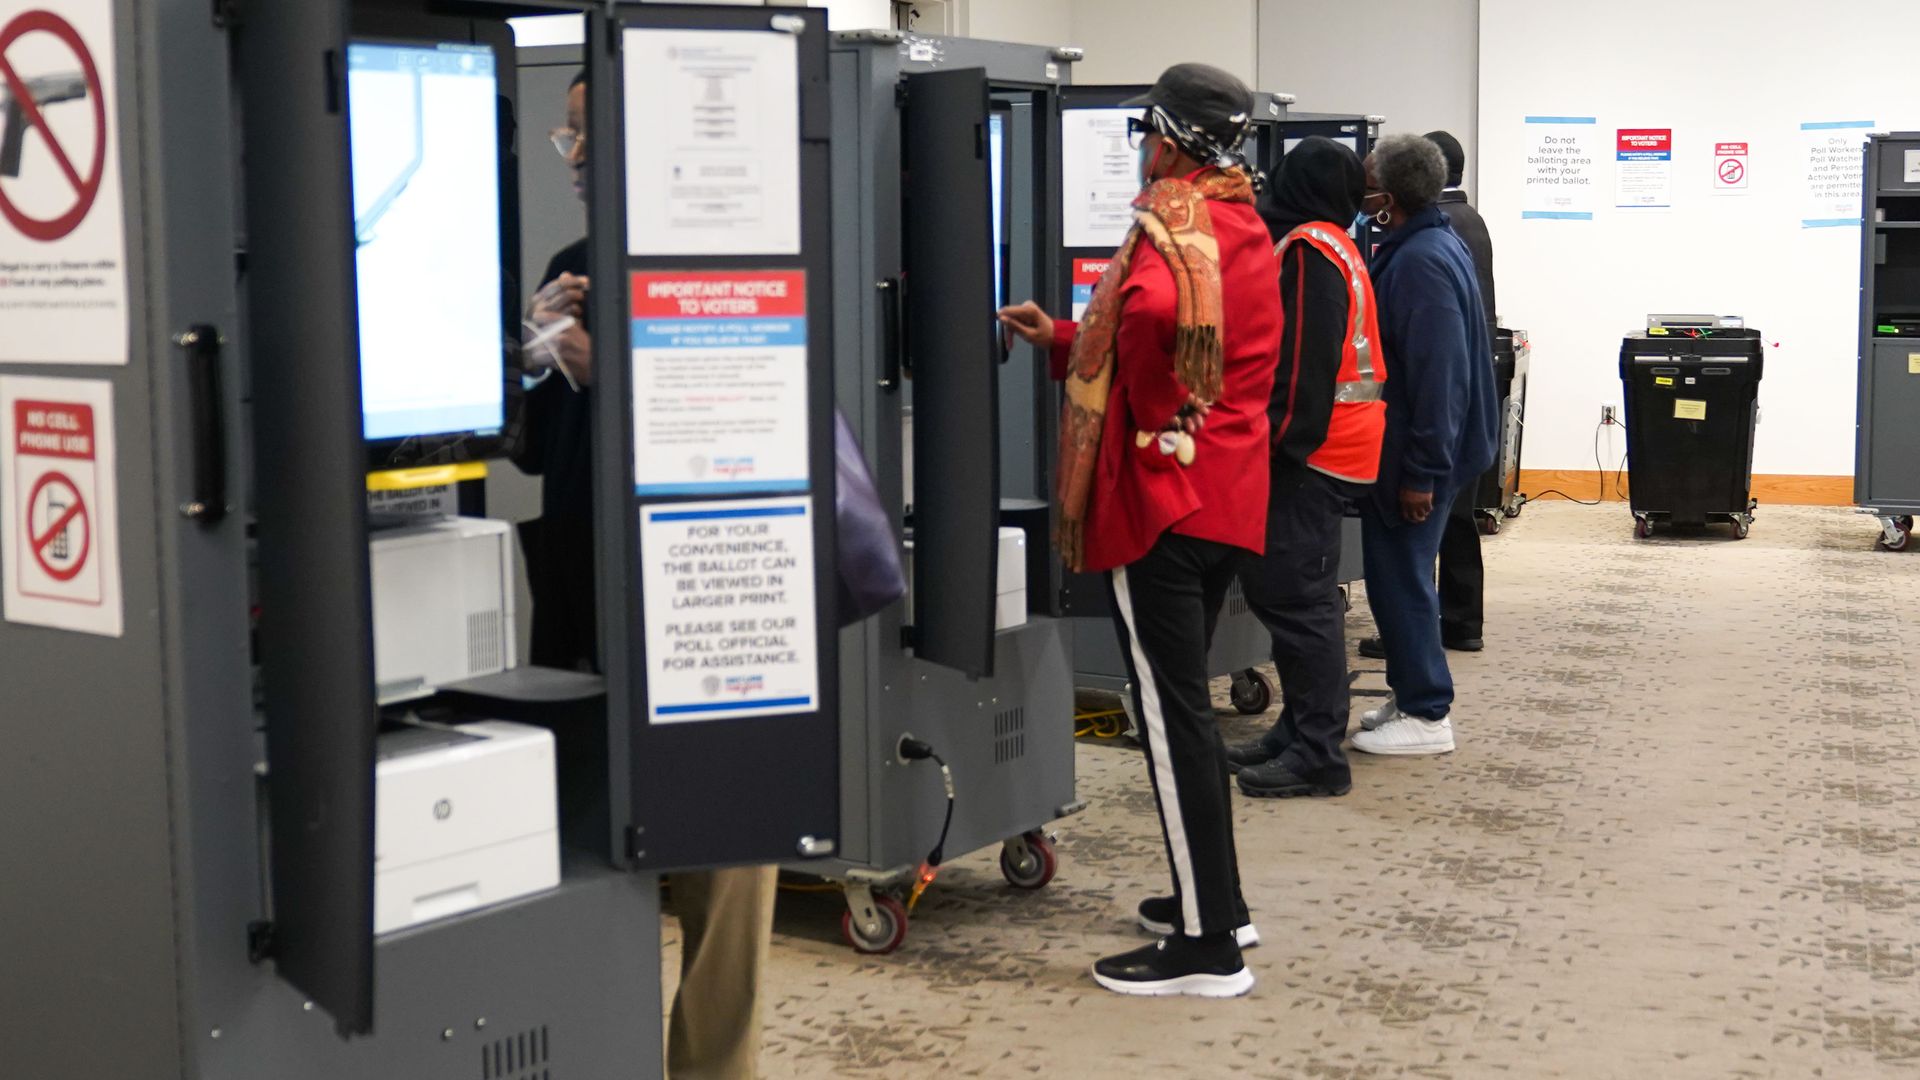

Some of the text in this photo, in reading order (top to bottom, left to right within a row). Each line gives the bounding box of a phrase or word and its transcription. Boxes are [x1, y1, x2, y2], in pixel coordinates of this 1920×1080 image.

[1544, 136, 1558, 144] Do
[1538, 146, 1581, 154] leave the
[1527, 156, 1568, 166] balloting
[1537, 166, 1581, 176] with your
[1808, 173, 1840, 182] Actively
[1526, 176, 1560, 185] printed
[648, 280, 787, 298] IMPORTANT NOTICE
[678, 297, 759, 315] TO VOTERS
[27, 411, 80, 431] NO CELL
[19, 431, 89, 453] PHONE USE
[687, 523, 769, 539] FOR YOUR
[668, 540, 788, 558] CONVENIENCE,
[663, 557, 796, 575] THE BALLOT CAN
[676, 575, 783, 591] BE VIEWED IN
[672, 591, 788, 610] LARGER PRINT.
[665, 617, 796, 636] PLEASE SEE OUR
[673, 636, 788, 653] POLL OFFICIAL
[663, 651, 799, 671] FOR ASSISTANCE.
